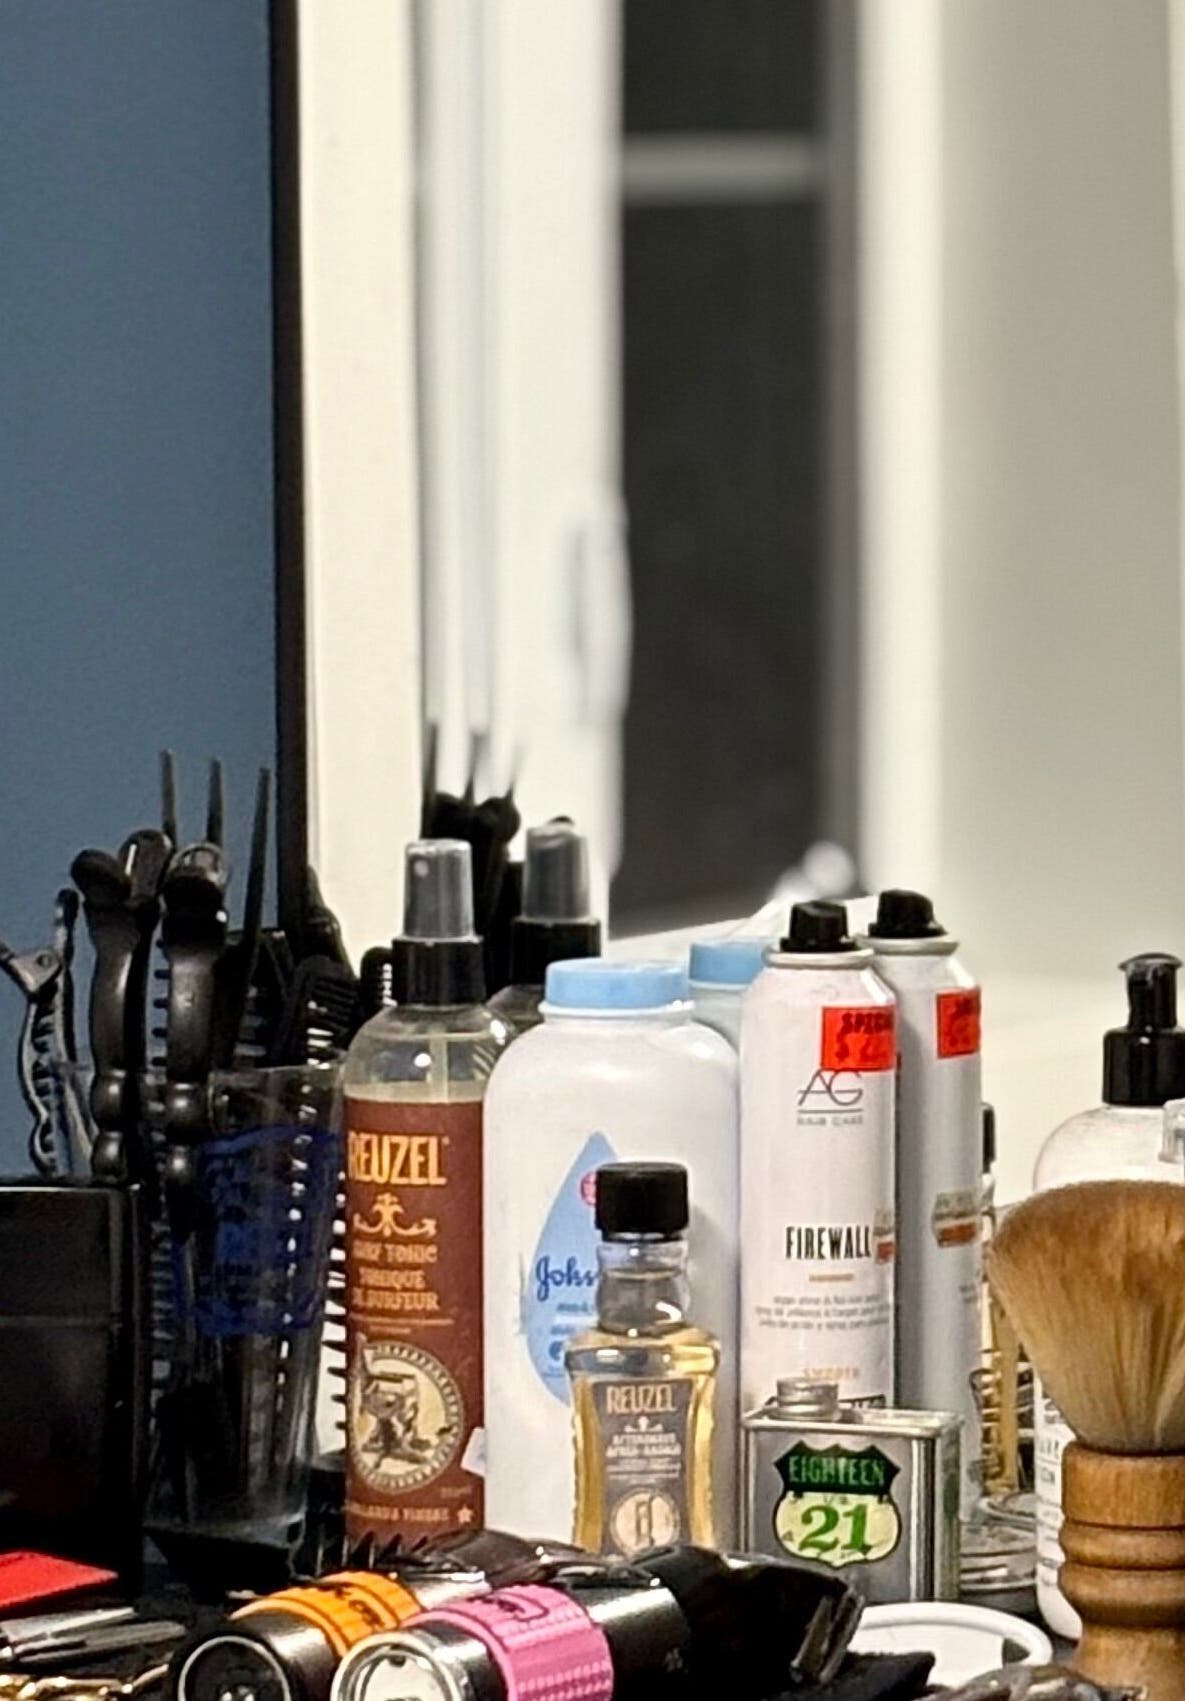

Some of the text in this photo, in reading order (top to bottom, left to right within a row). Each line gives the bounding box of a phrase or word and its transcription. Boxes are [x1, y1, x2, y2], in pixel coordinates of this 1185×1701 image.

[348, 1130, 447, 1185] REUZEL
[785, 1225, 871, 1261] FIREWALL
[606, 1384, 677, 1415] REUZEL
[788, 1455, 885, 1486] EIGHTEEN
[798, 1503, 873, 1553] 21
